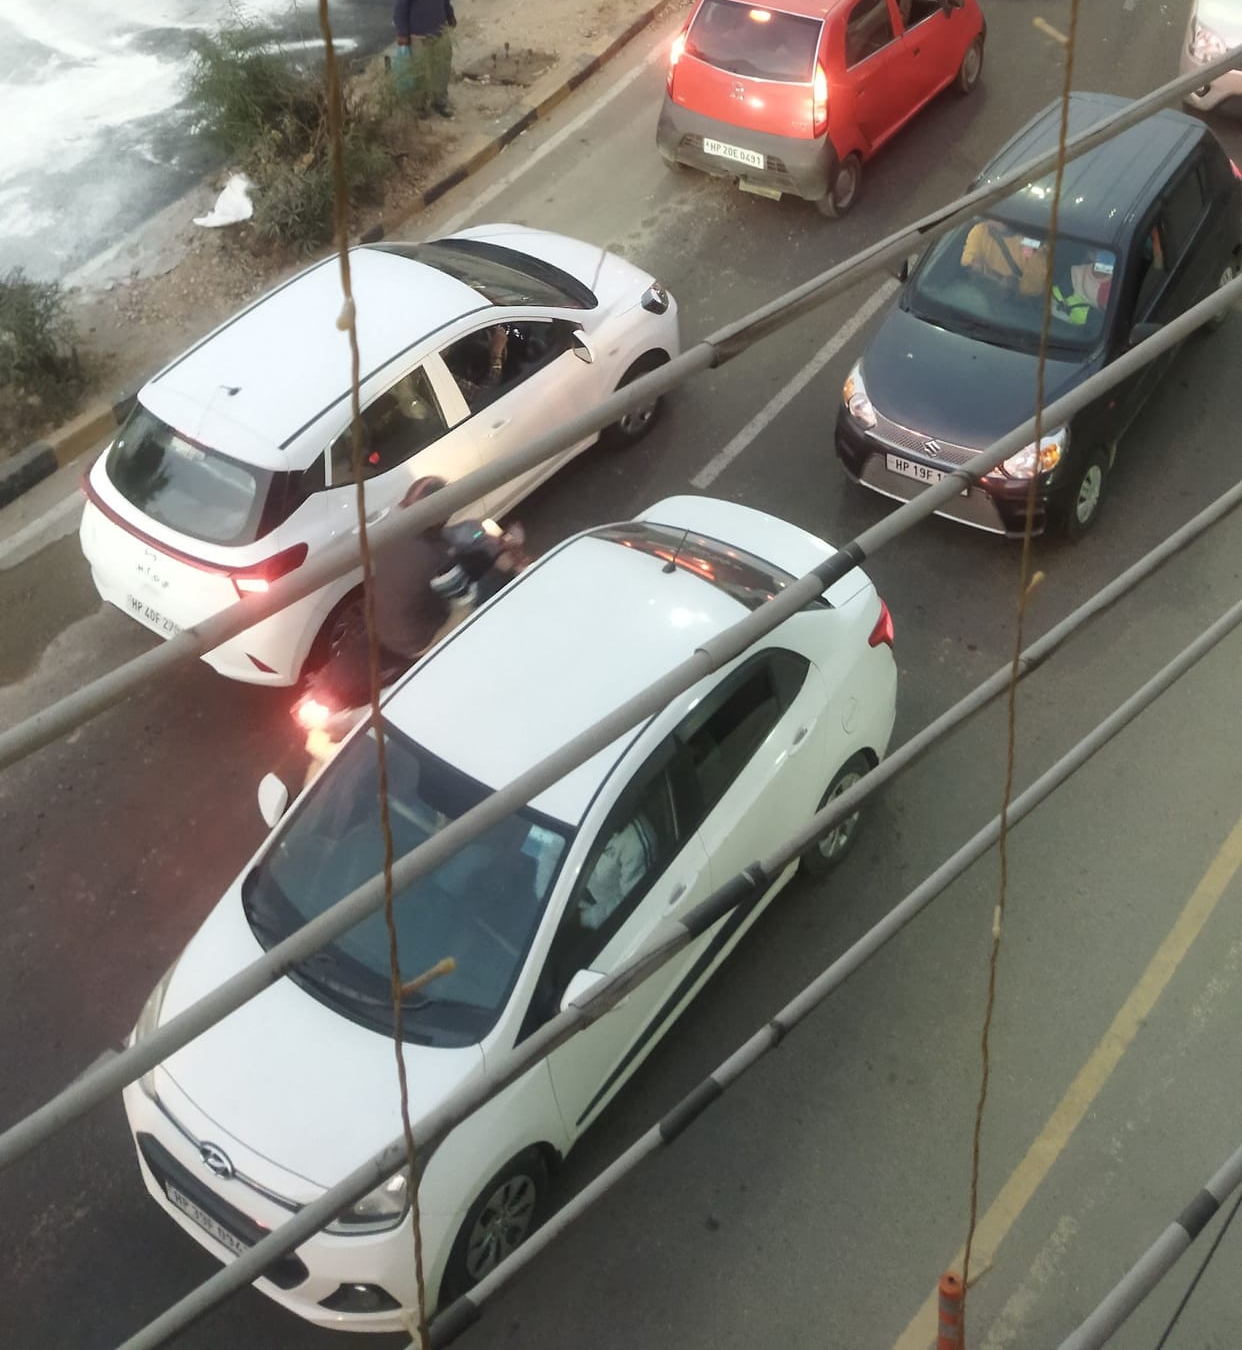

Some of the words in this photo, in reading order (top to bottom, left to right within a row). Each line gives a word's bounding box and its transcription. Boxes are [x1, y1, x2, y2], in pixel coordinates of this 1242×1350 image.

[895, 459, 910, 471] HP
[913, 465, 934, 481] 19F
[132, 596, 143, 611] HP
